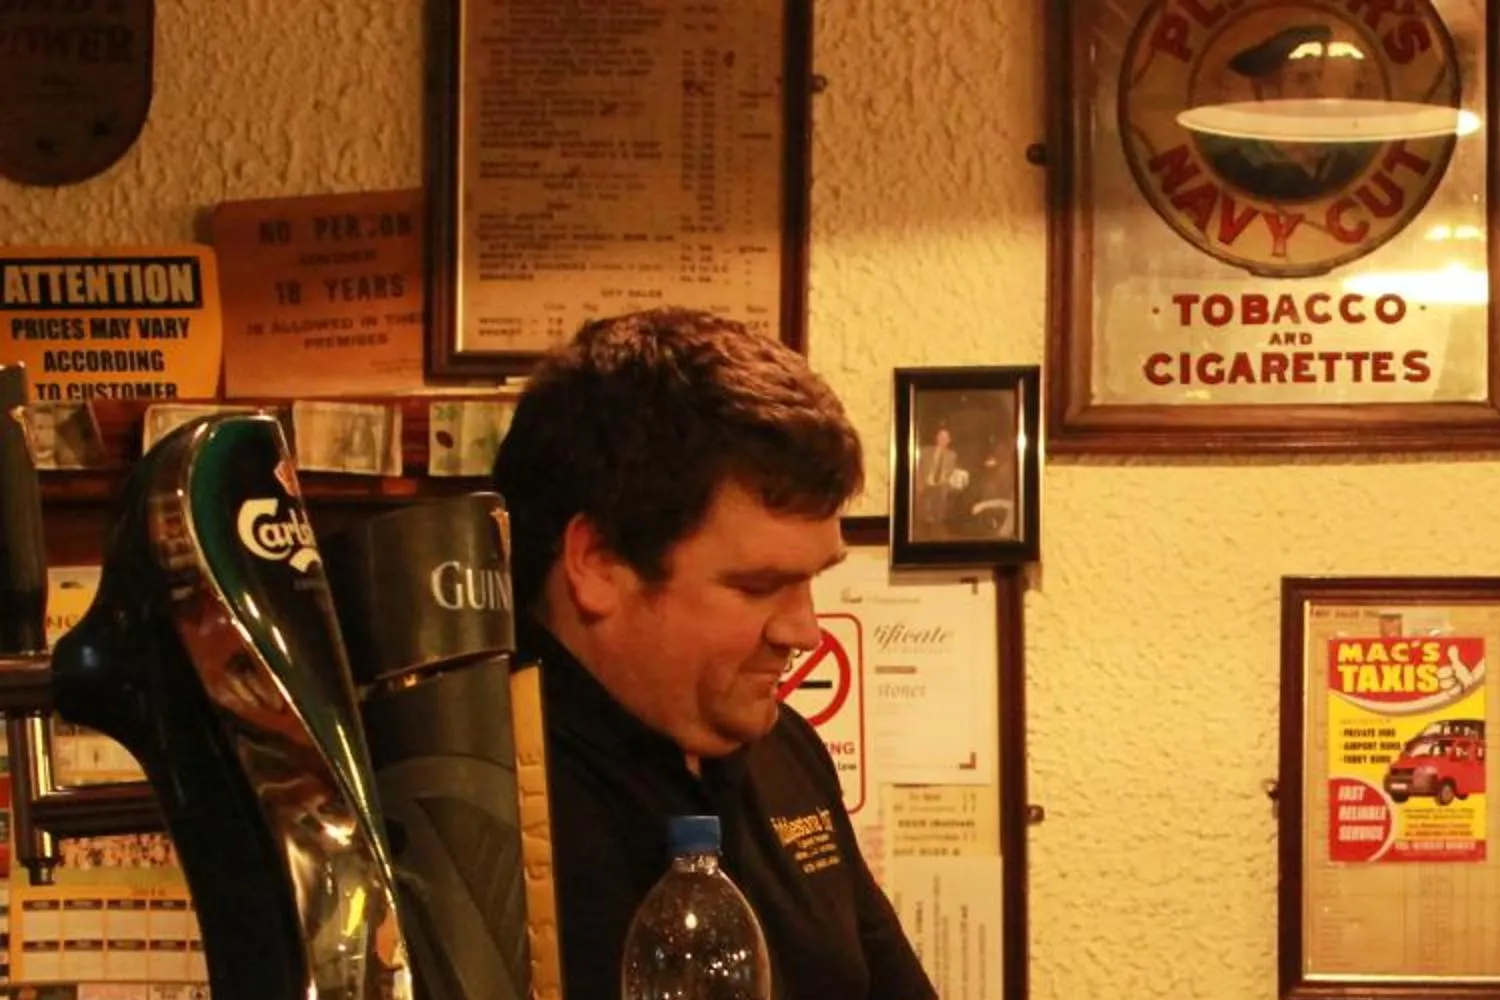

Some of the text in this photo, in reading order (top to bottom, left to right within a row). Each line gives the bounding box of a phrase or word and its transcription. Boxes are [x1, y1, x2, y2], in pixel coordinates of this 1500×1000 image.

[1148, 146, 1433, 257] NAVY CUT
[3, 263, 194, 306] ATTENTION
[322, 273, 405, 303] YEARS
[1173, 293, 1407, 327] TOBACCO
[11, 317, 191, 340] PRICES MAY VARY
[1268, 333, 1312, 346] AND
[43, 351, 164, 373] ACCORDING
[1142, 351, 1432, 386] CIGARETTES
[35, 384, 178, 400] TO CUSTOMER
[1337, 641, 1441, 664] MAC'S
[1337, 665, 1438, 694] TAXIS
[1337, 784, 1366, 801] FAST
[1338, 805, 1388, 821] RELIABLE
[1338, 825, 1386, 842] SERVICE
